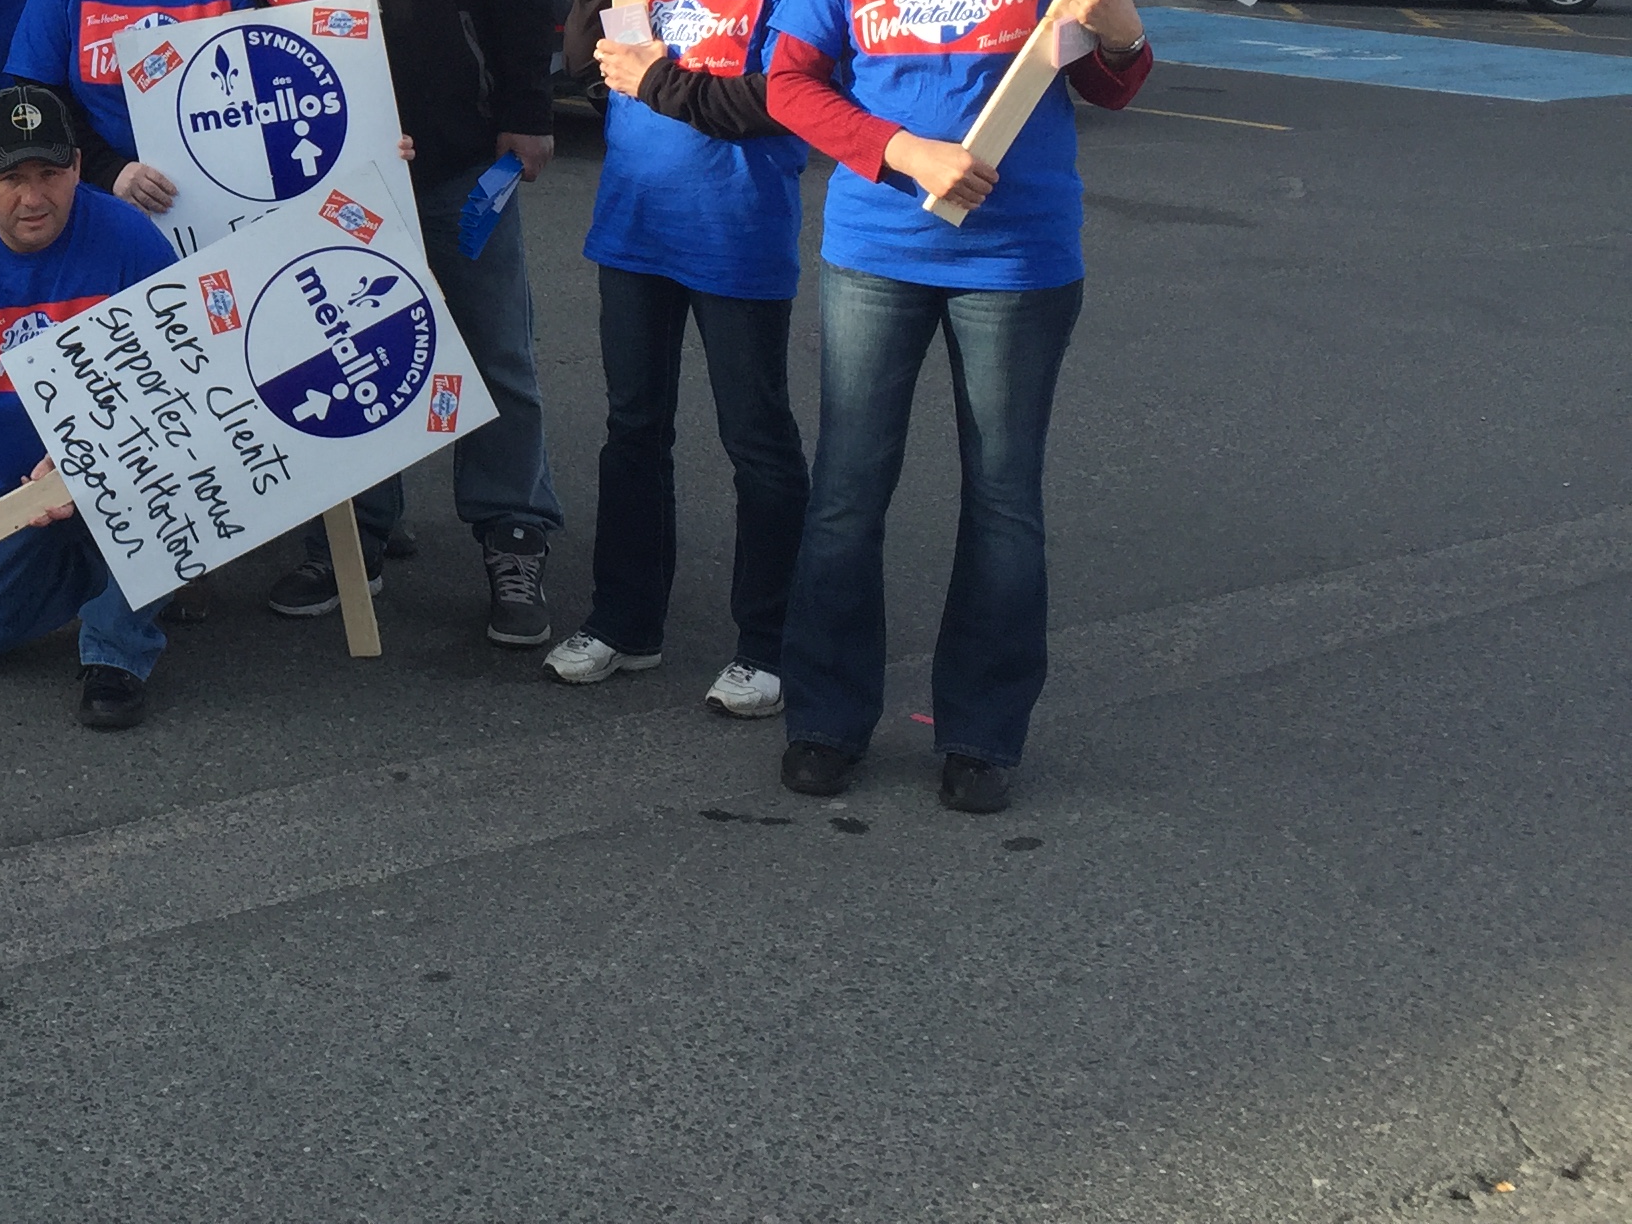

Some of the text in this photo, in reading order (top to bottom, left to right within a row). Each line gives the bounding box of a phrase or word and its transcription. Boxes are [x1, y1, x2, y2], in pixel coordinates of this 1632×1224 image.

[900, 0, 987, 26] Métallos
[248, 30, 335, 86] SYNDICAT
[272, 76, 293, 86] des
[190, 84, 341, 135] métallos
[294, 266, 389, 424] métallos
[375, 345, 390, 367] des
[390, 306, 430, 409] SYNDICAT
